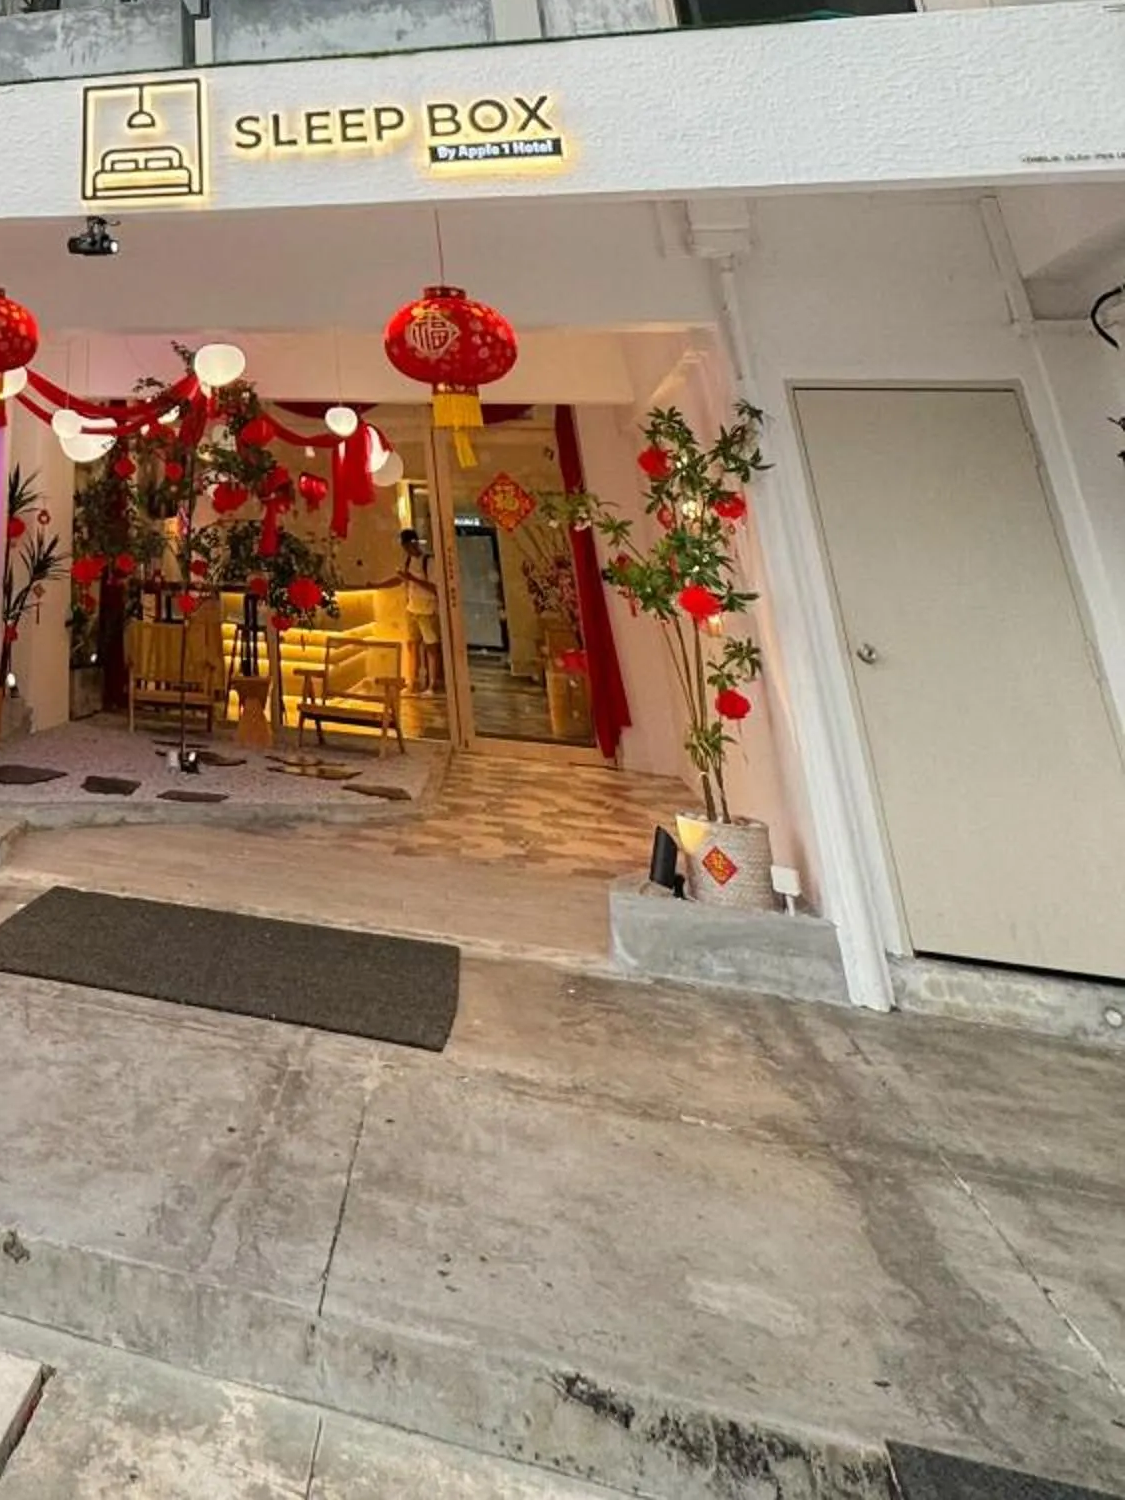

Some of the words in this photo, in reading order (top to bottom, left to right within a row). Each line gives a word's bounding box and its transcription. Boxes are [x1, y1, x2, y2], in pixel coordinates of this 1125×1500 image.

[234, 107, 405, 149] SLEEP
[427, 95, 554, 137] BOX
[436, 145, 456, 160] By
[458, 143, 500, 159] Apple
[501, 142, 510, 154] 1
[512, 139, 554, 154] Hotel
